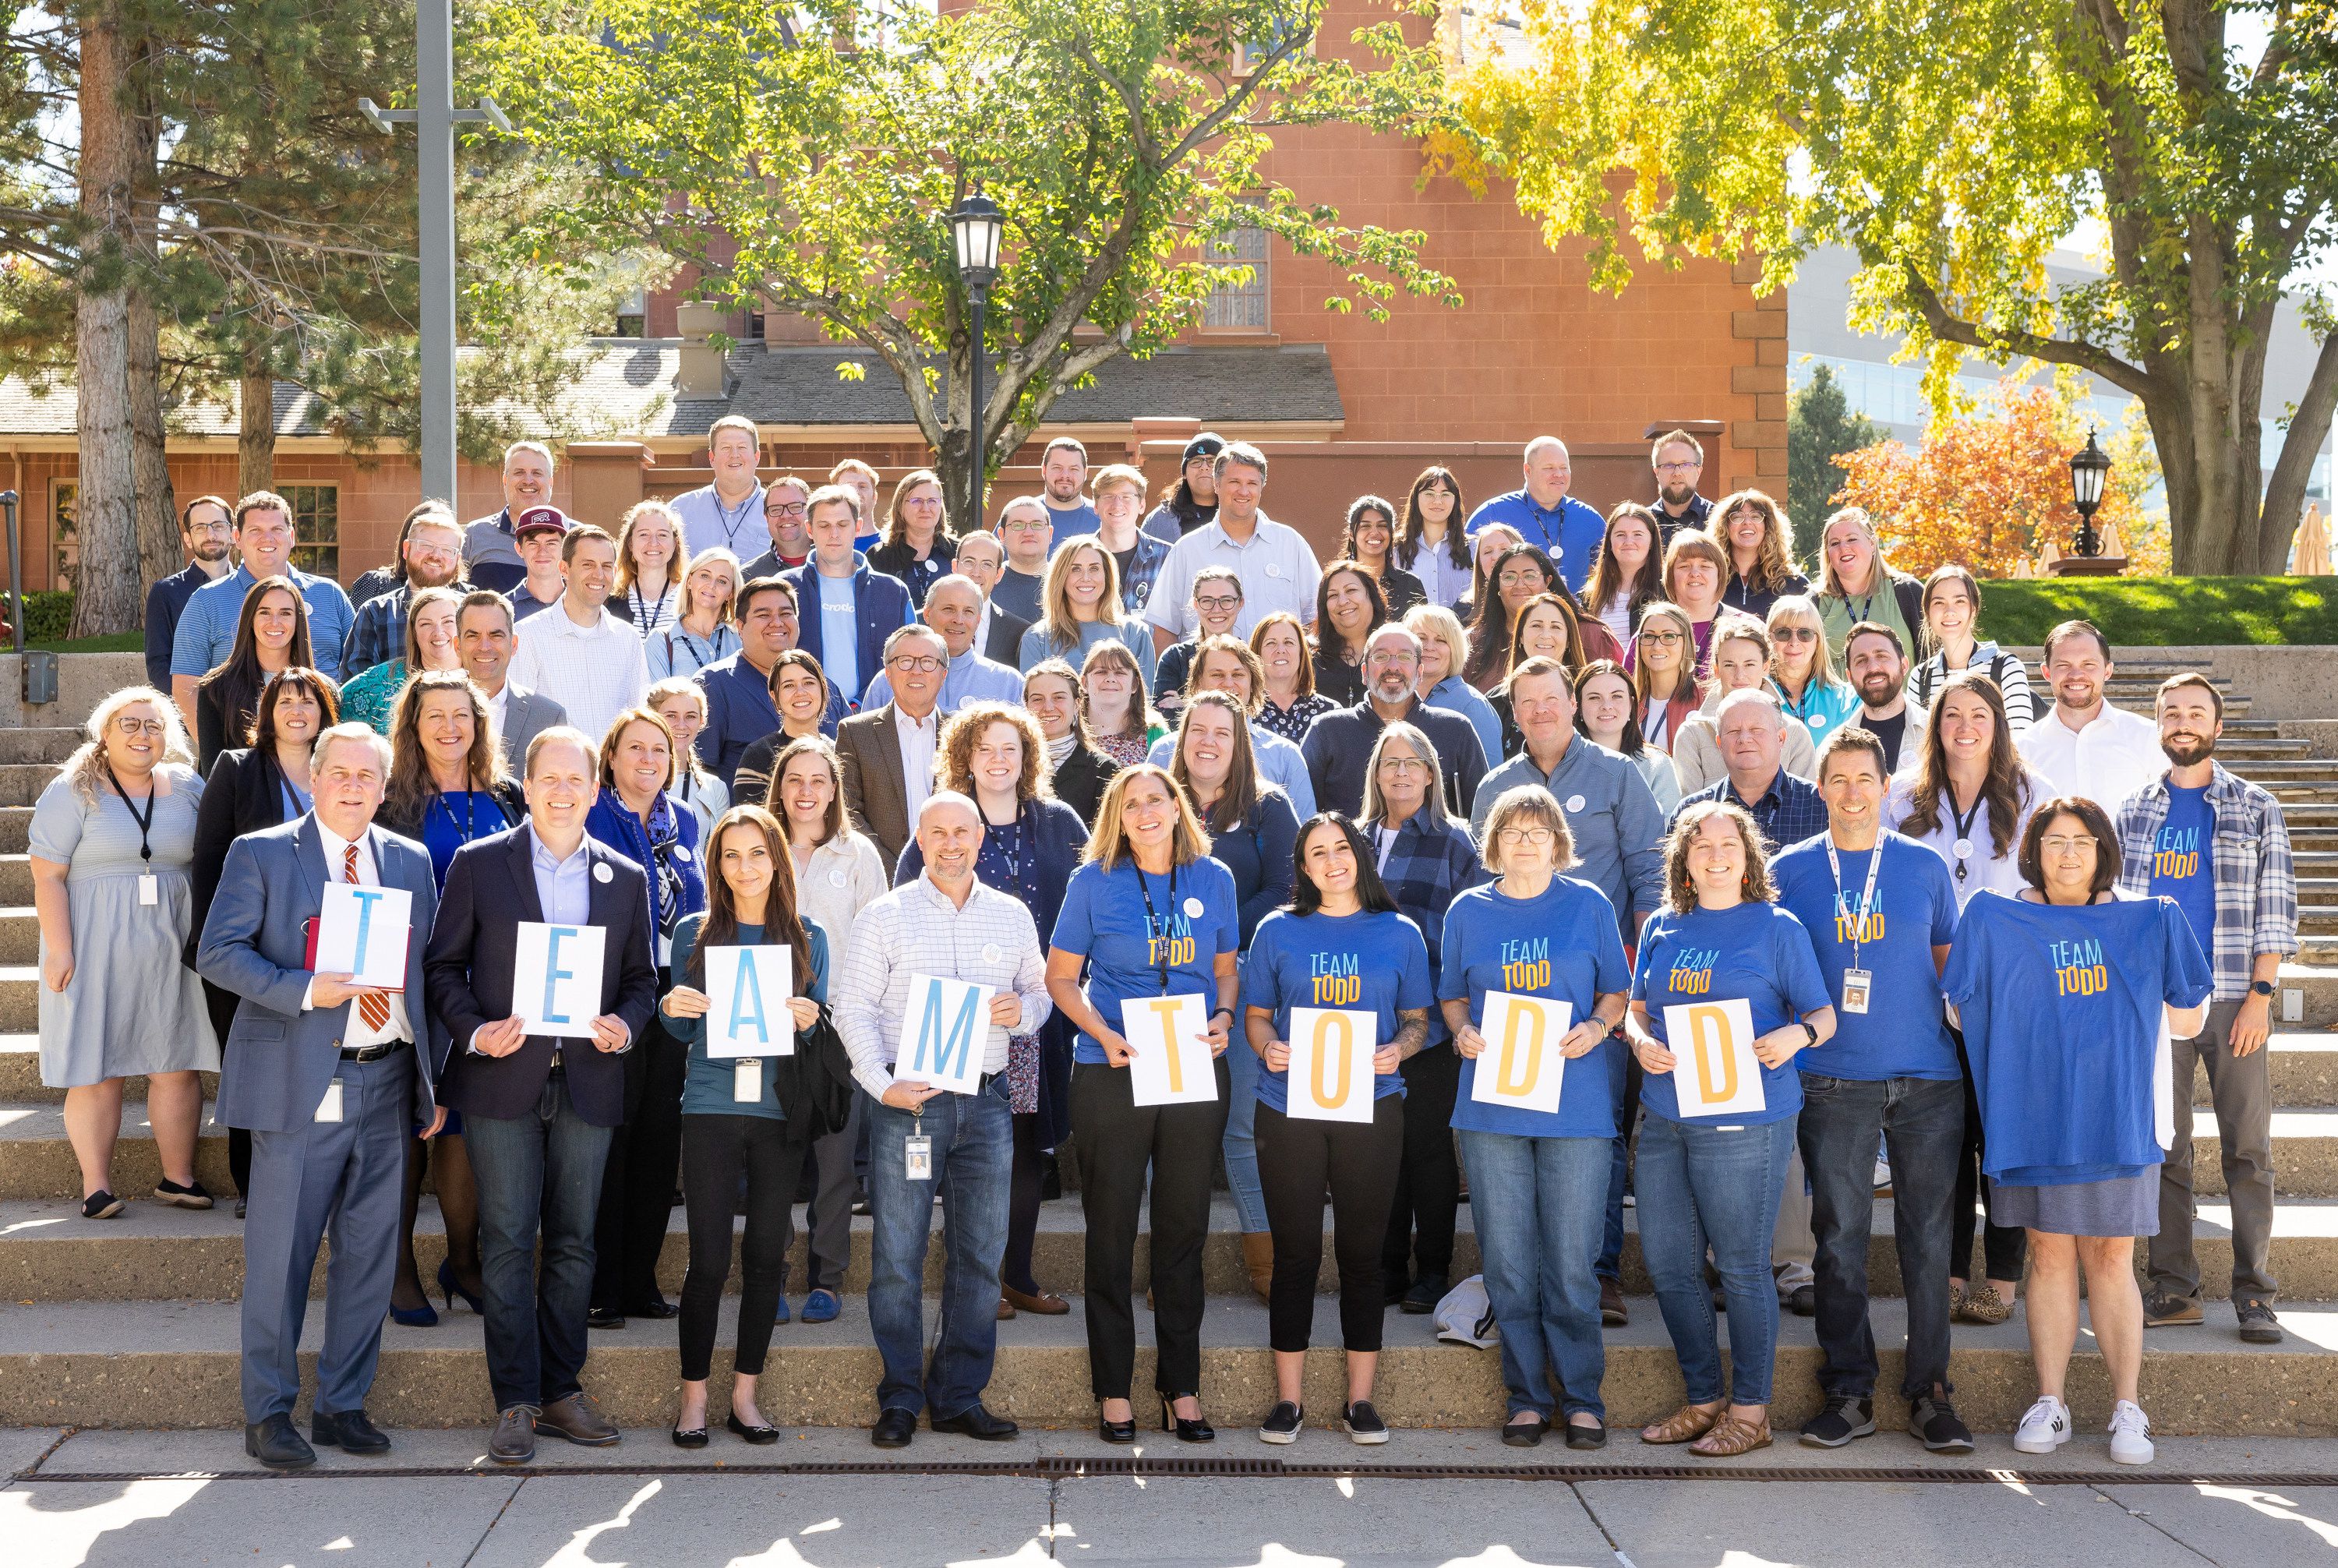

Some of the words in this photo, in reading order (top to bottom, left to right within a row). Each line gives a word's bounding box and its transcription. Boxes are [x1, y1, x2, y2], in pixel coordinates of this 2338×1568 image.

[2154, 826, 2199, 854] TEAM
[2154, 850, 2198, 879] TODD
[1832, 889, 1882, 916] TEAM
[353, 891, 383, 975] T
[1834, 913, 1885, 944] TODD
[1310, 952, 1358, 977] TEAM
[1501, 938, 1548, 964] TEAM
[1672, 947, 1721, 972] TEAM
[2050, 938, 2103, 969] TEAM
[543, 928, 577, 1023] E
[1312, 974, 1361, 1005] TODD
[1502, 959, 1551, 991] TODD
[1669, 968, 1712, 994] TODD
[2055, 965, 2107, 996] TODD
[728, 949, 768, 1043] A
[913, 979, 980, 1079] M
[1150, 1000, 1183, 1093] T
[1310, 1012, 1351, 1109] O
[1496, 999, 1545, 1097] D
[1689, 1005, 1738, 1104] D
